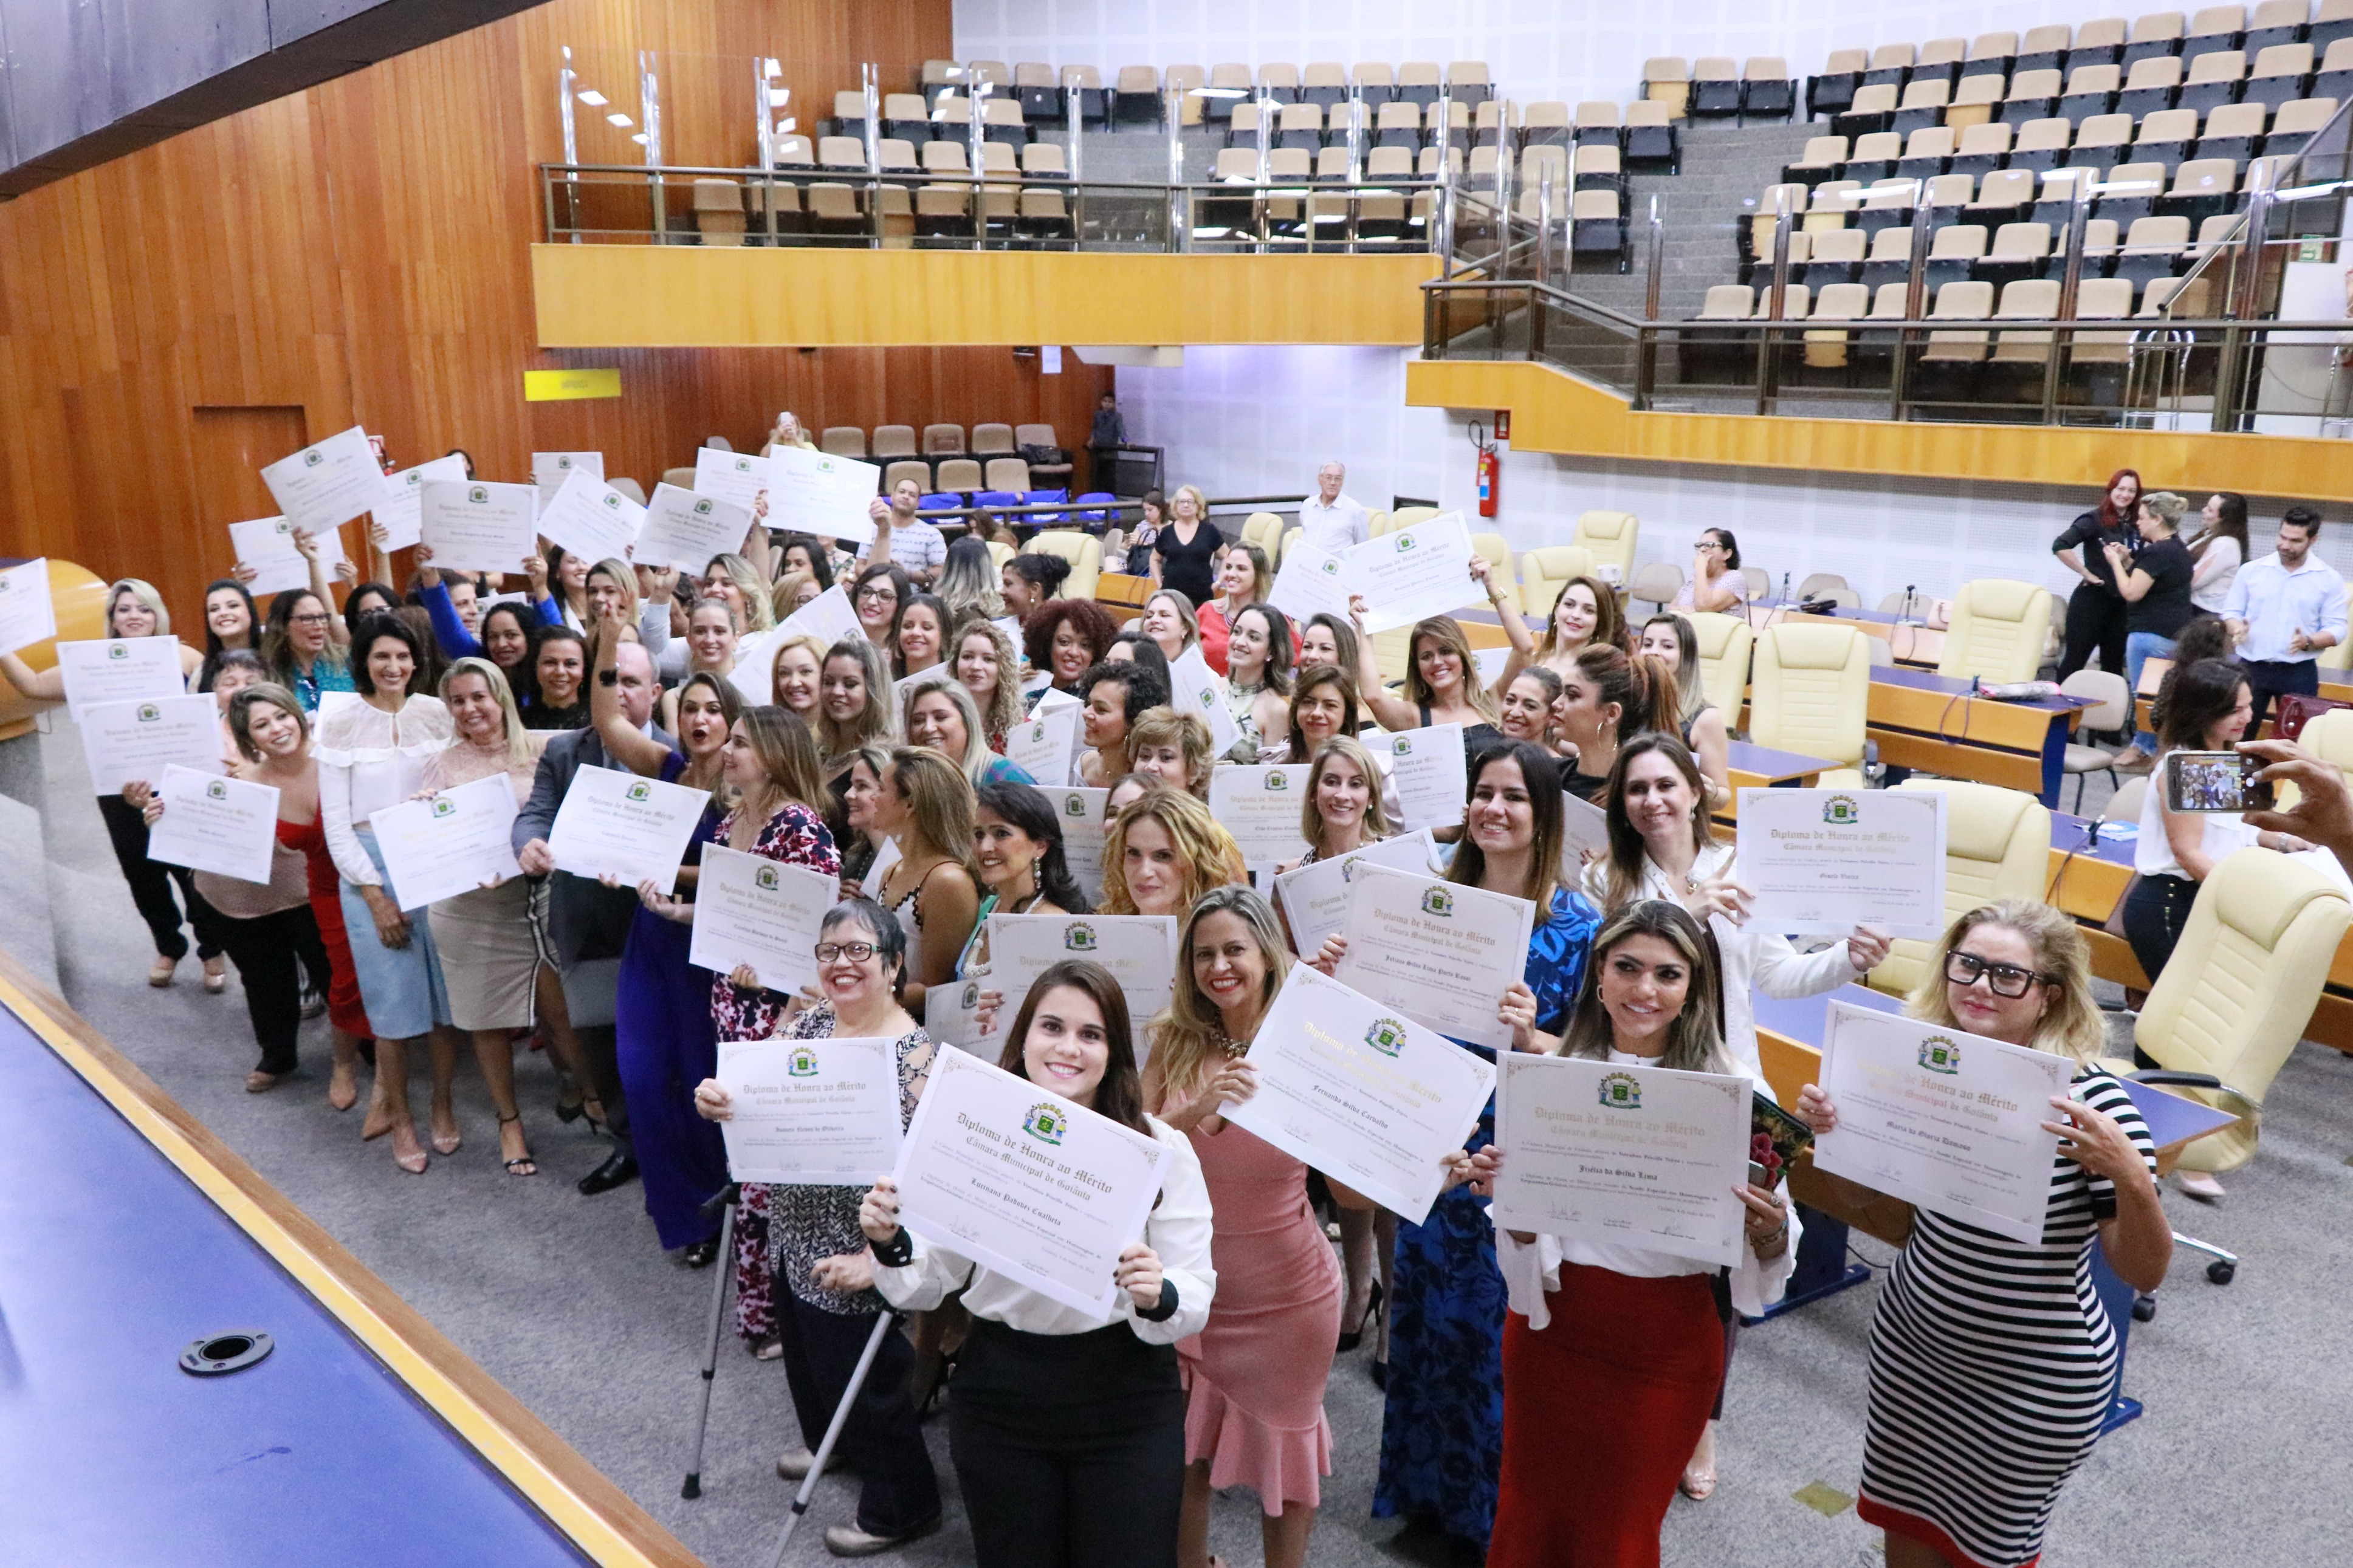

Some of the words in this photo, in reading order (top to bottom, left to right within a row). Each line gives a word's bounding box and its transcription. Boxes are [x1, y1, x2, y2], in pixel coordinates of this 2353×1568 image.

[1369, 562, 1393, 574] Diploma
[1402, 553, 1420, 563] Honra
[1430, 543, 1450, 553] Mérito
[588, 795, 612, 807] Diploma
[623, 803, 643, 813] Honra
[653, 809, 675, 820] Mérito
[1770, 829, 1810, 840] Diploma
[1813, 831, 1823, 840] de
[1827, 830, 1858, 841] Honra
[1877, 832, 1910, 843] Mérito
[1815, 844, 1852, 853] Municipal
[719, 882, 746, 897] Diploma
[747, 889, 754, 899] de
[756, 892, 778, 905] Honra
[788, 902, 811, 915] Mérito
[1310, 895, 1341, 910] Diploma
[1373, 907, 1408, 925] Diploma
[1410, 917, 1420, 928] de
[1423, 920, 1450, 934] Honra
[1452, 930, 1462, 939] ao
[1466, 930, 1496, 945] Mérito
[1383, 923, 1409, 936] Câmara
[1410, 930, 1443, 946] Municipal
[1445, 939, 1453, 948] de
[1454, 941, 1482, 954] Goiânia
[1020, 956, 1054, 966] Diploma
[1385, 954, 1405, 965] Juliana
[1406, 959, 1421, 968] Silva
[1422, 964, 1437, 972] Lima
[1438, 967, 1454, 977] Porto
[1302, 1021, 1345, 1051] Diploma
[1346, 1044, 1359, 1058] de
[1407, 1078, 1443, 1103] Mérito
[743, 1083, 778, 1095] Diploma
[781, 1083, 789, 1092] de
[793, 1082, 820, 1092] Honra
[836, 1080, 866, 1090] Mérito
[784, 1096, 817, 1105] Municipal
[1905, 1072, 1917, 1084] de
[1918, 1075, 1957, 1095] Honra
[1960, 1089, 1973, 1100] ao
[1977, 1091, 2018, 1111] Mérito
[1311, 1083, 1342, 1104] Fernanda
[1342, 1099, 1361, 1114] Silva
[1360, 1109, 1389, 1129] Carvalho
[1904, 1089, 1948, 1108] Municipal
[1950, 1101, 1959, 1111] de
[1962, 1104, 1999, 1121] Goiânia
[1534, 1106, 1583, 1125] Diploma
[1586, 1112, 1600, 1124] de
[1604, 1114, 1642, 1129] Honra
[1646, 1121, 1660, 1131] ao
[1664, 1121, 1706, 1137] Mérito
[1550, 1125, 1586, 1137] Câmara
[1886, 1120, 1907, 1132] Maria
[1908, 1127, 1916, 1135] da
[955, 1111, 1003, 1142] Diploma
[1004, 1134, 1017, 1149] de
[1019, 1142, 1056, 1167] Honra
[1057, 1163, 1071, 1176] ao
[1074, 1166, 1113, 1193] Mérito
[965, 1134, 1000, 1156] Câmara
[1000, 1151, 1043, 1179] Municipal
[1044, 1172, 1056, 1184] de
[1056, 1177, 1093, 1200] Goiânia
[1604, 1167, 1613, 1176] da
[1614, 1168, 1636, 1178] Silva
[1637, 1171, 1658, 1181] Lima
